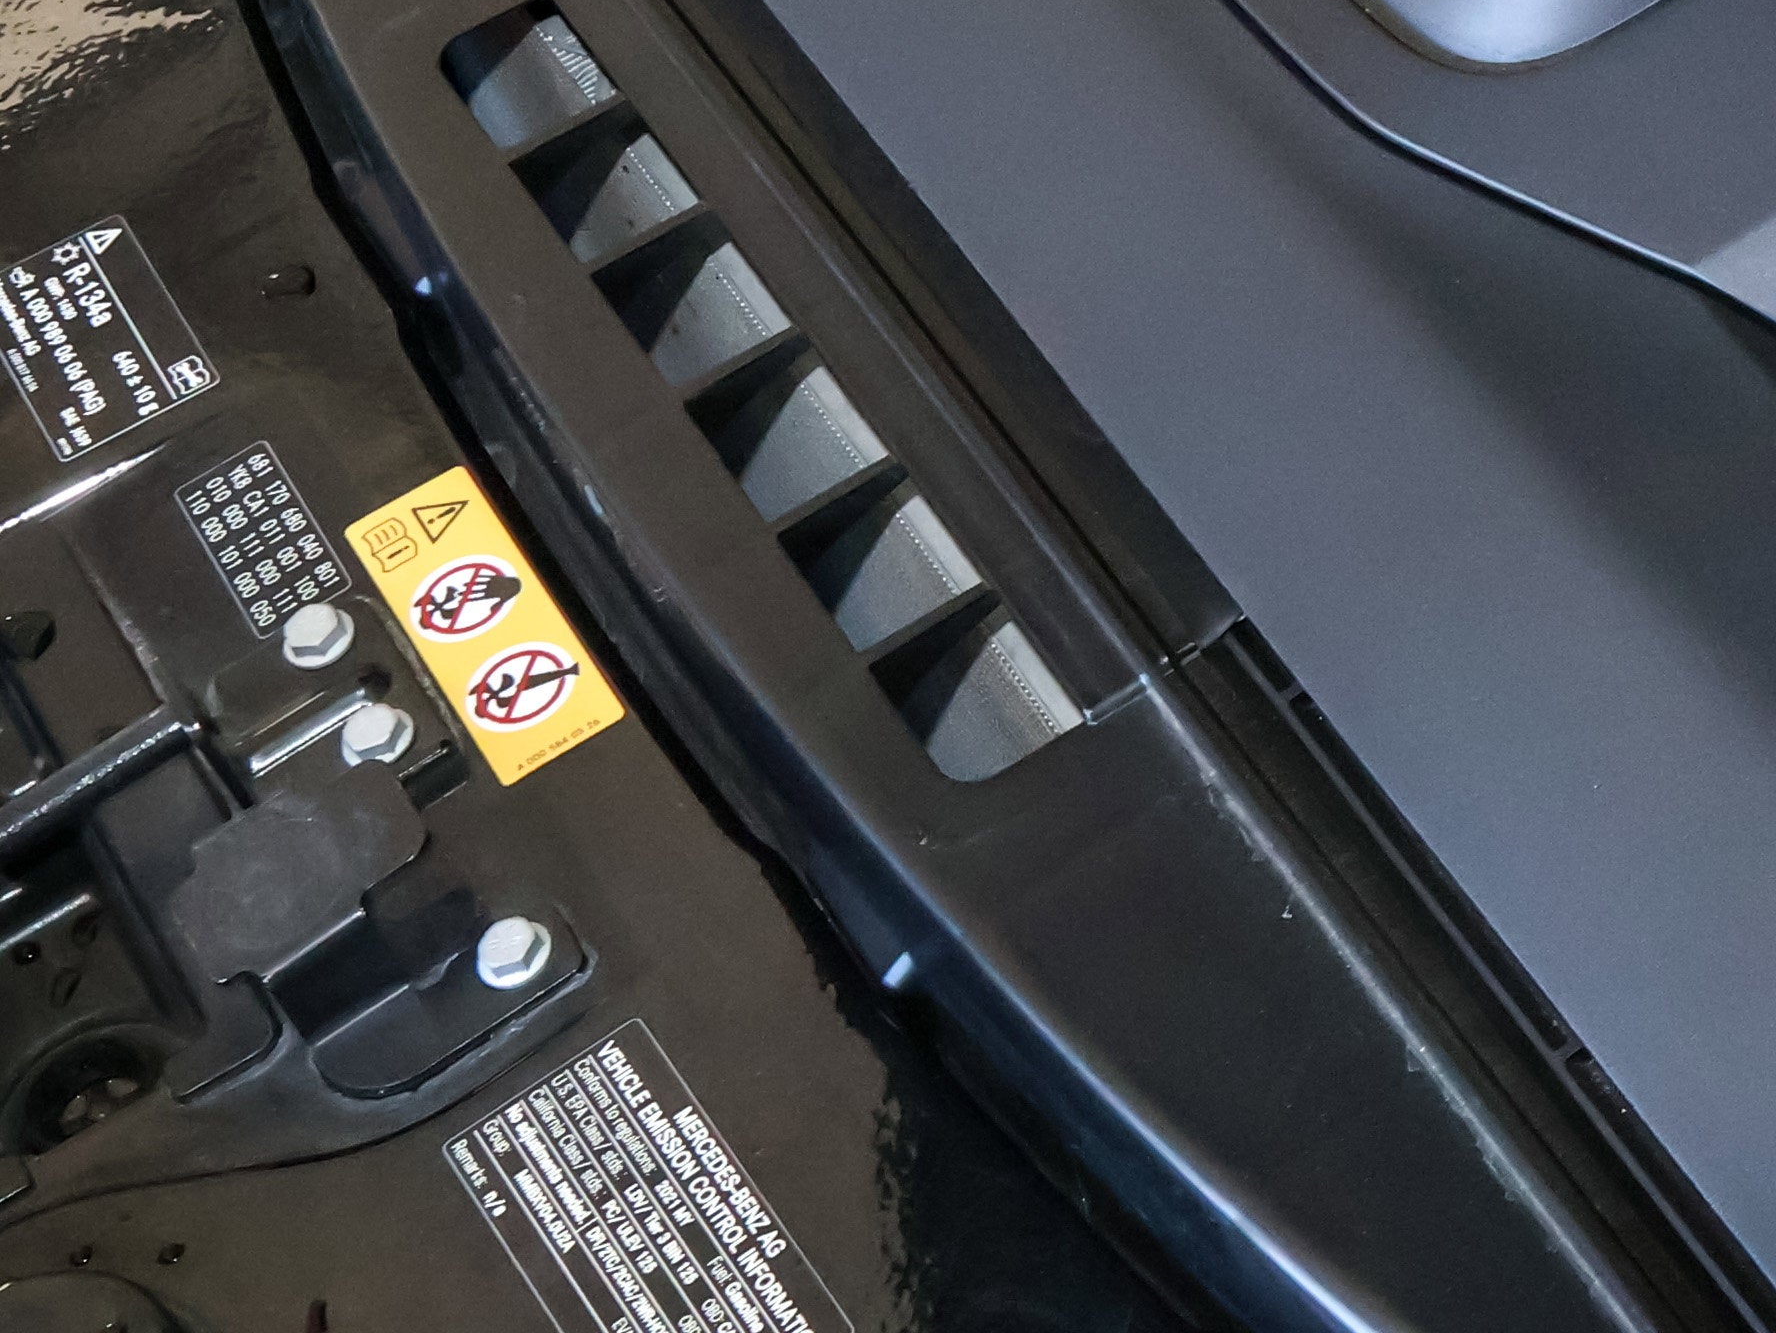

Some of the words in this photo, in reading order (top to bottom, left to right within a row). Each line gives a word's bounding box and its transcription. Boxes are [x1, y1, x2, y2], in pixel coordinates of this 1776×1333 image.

[19, 287, 40, 302] A
[26, 297, 53, 323] 000
[39, 320, 67, 345] 989
[63, 262, 112, 327] R-134a
[112, 350, 140, 376] 640
[133, 384, 156, 403] 10
[53, 344, 77, 364] 06
[63, 361, 88, 381] 06
[69, 378, 106, 416] (PAG)
[185, 489, 211, 515] 110
[200, 516, 227, 543] 000
[218, 544, 243, 570] 101
[233, 571, 260, 598] 000
[249, 599, 277, 627] 050
[205, 476, 232, 503] 010
[221, 503, 248, 530] 000
[239, 531, 265, 557] 111
[254, 558, 281, 585] 000
[272, 587, 298, 613] 111
[242, 490, 270, 517] CA1
[258, 518, 286, 545] 011
[276, 545, 302, 572] 001
[293, 575, 320, 601] 100
[247, 453, 274, 478] 681
[264, 479, 291, 505] 170
[280, 507, 307, 532] 680
[296, 533, 324, 560] 040
[313, 560, 340, 587] 801
[482, 1118, 510, 1156] Group:
[550, 1071, 574, 1099] U.S.
[564, 1093, 589, 1120] EPA
[597, 1040, 651, 1108] VEHICLE
[637, 1102, 700, 1180] EMISSION
[688, 1176, 747, 1254] CONTROL
[451, 1138, 487, 1189] Remarks:
[504, 1102, 524, 1124] No
[515, 1121, 563, 1184] adjustments
[555, 1180, 591, 1225] needed.
[528, 1088, 566, 1138] California
[601, 1198, 626, 1224] PC/
[615, 1220, 645, 1252] ULEV
[573, 1058, 612, 1109] Conforms
[604, 1103, 620, 1120] to
[612, 1117, 656, 1175] regulations:
[654, 1179, 682, 1210] 2021
[671, 1205, 695, 1226] MY
[706, 1255, 733, 1287] Fuel:
[724, 1281, 764, 1333] Gasoline
[674, 1106, 770, 1233] MERCEDES-BENZ
[756, 1230, 787, 1258] AG
